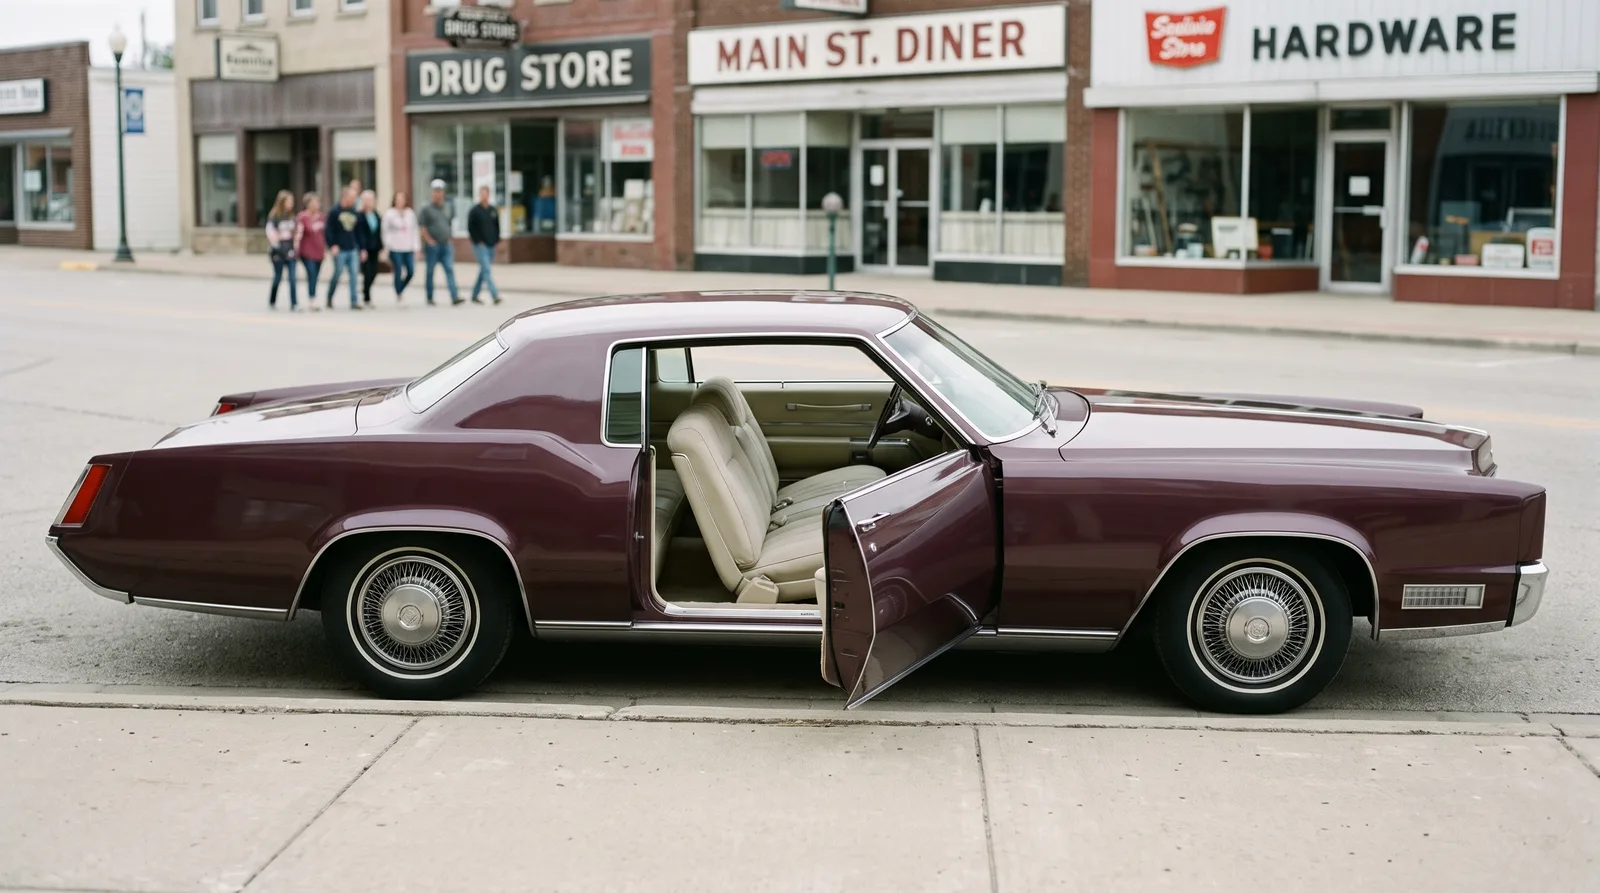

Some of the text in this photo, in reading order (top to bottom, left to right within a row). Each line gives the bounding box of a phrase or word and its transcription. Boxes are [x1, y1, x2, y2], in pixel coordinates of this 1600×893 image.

[444, 19, 516, 40] DRUG STORE
[717, 21, 1026, 72] MAIN ST. DINER
[1253, 13, 1517, 61] HARDWARE
[419, 48, 634, 97] DRUG STORE
